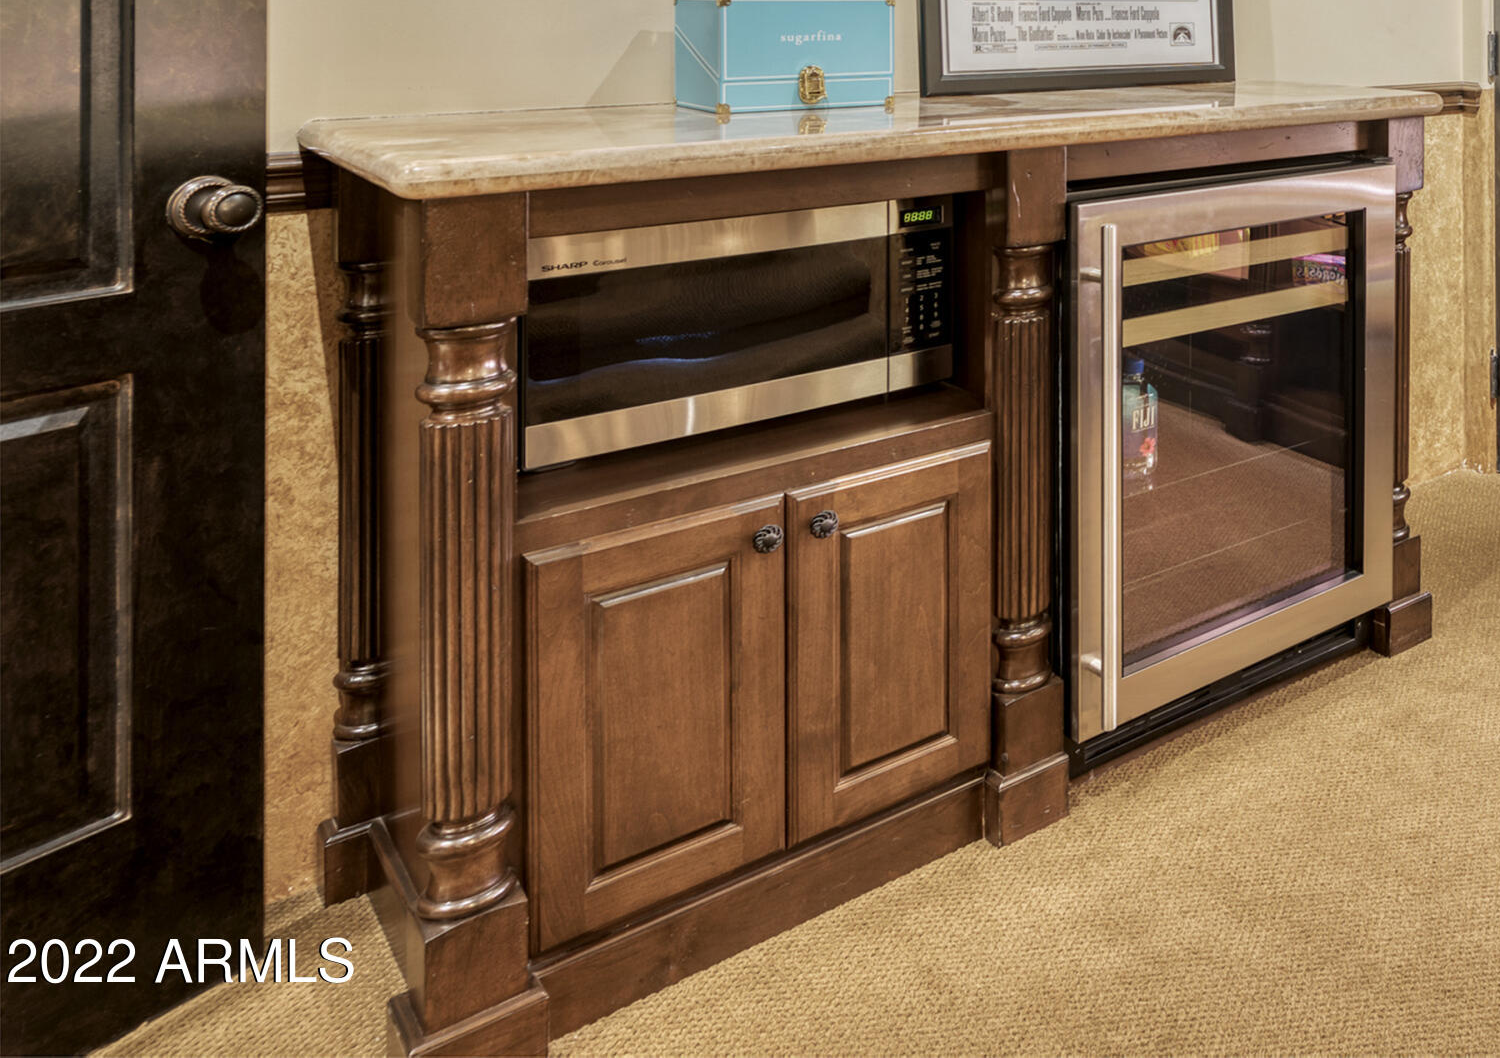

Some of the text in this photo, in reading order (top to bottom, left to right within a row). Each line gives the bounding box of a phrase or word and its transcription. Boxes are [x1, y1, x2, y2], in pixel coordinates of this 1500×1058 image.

[780, 30, 843, 46] sugarfina
[541, 261, 588, 273] SHARP
[1132, 405, 1155, 431] FIJI
